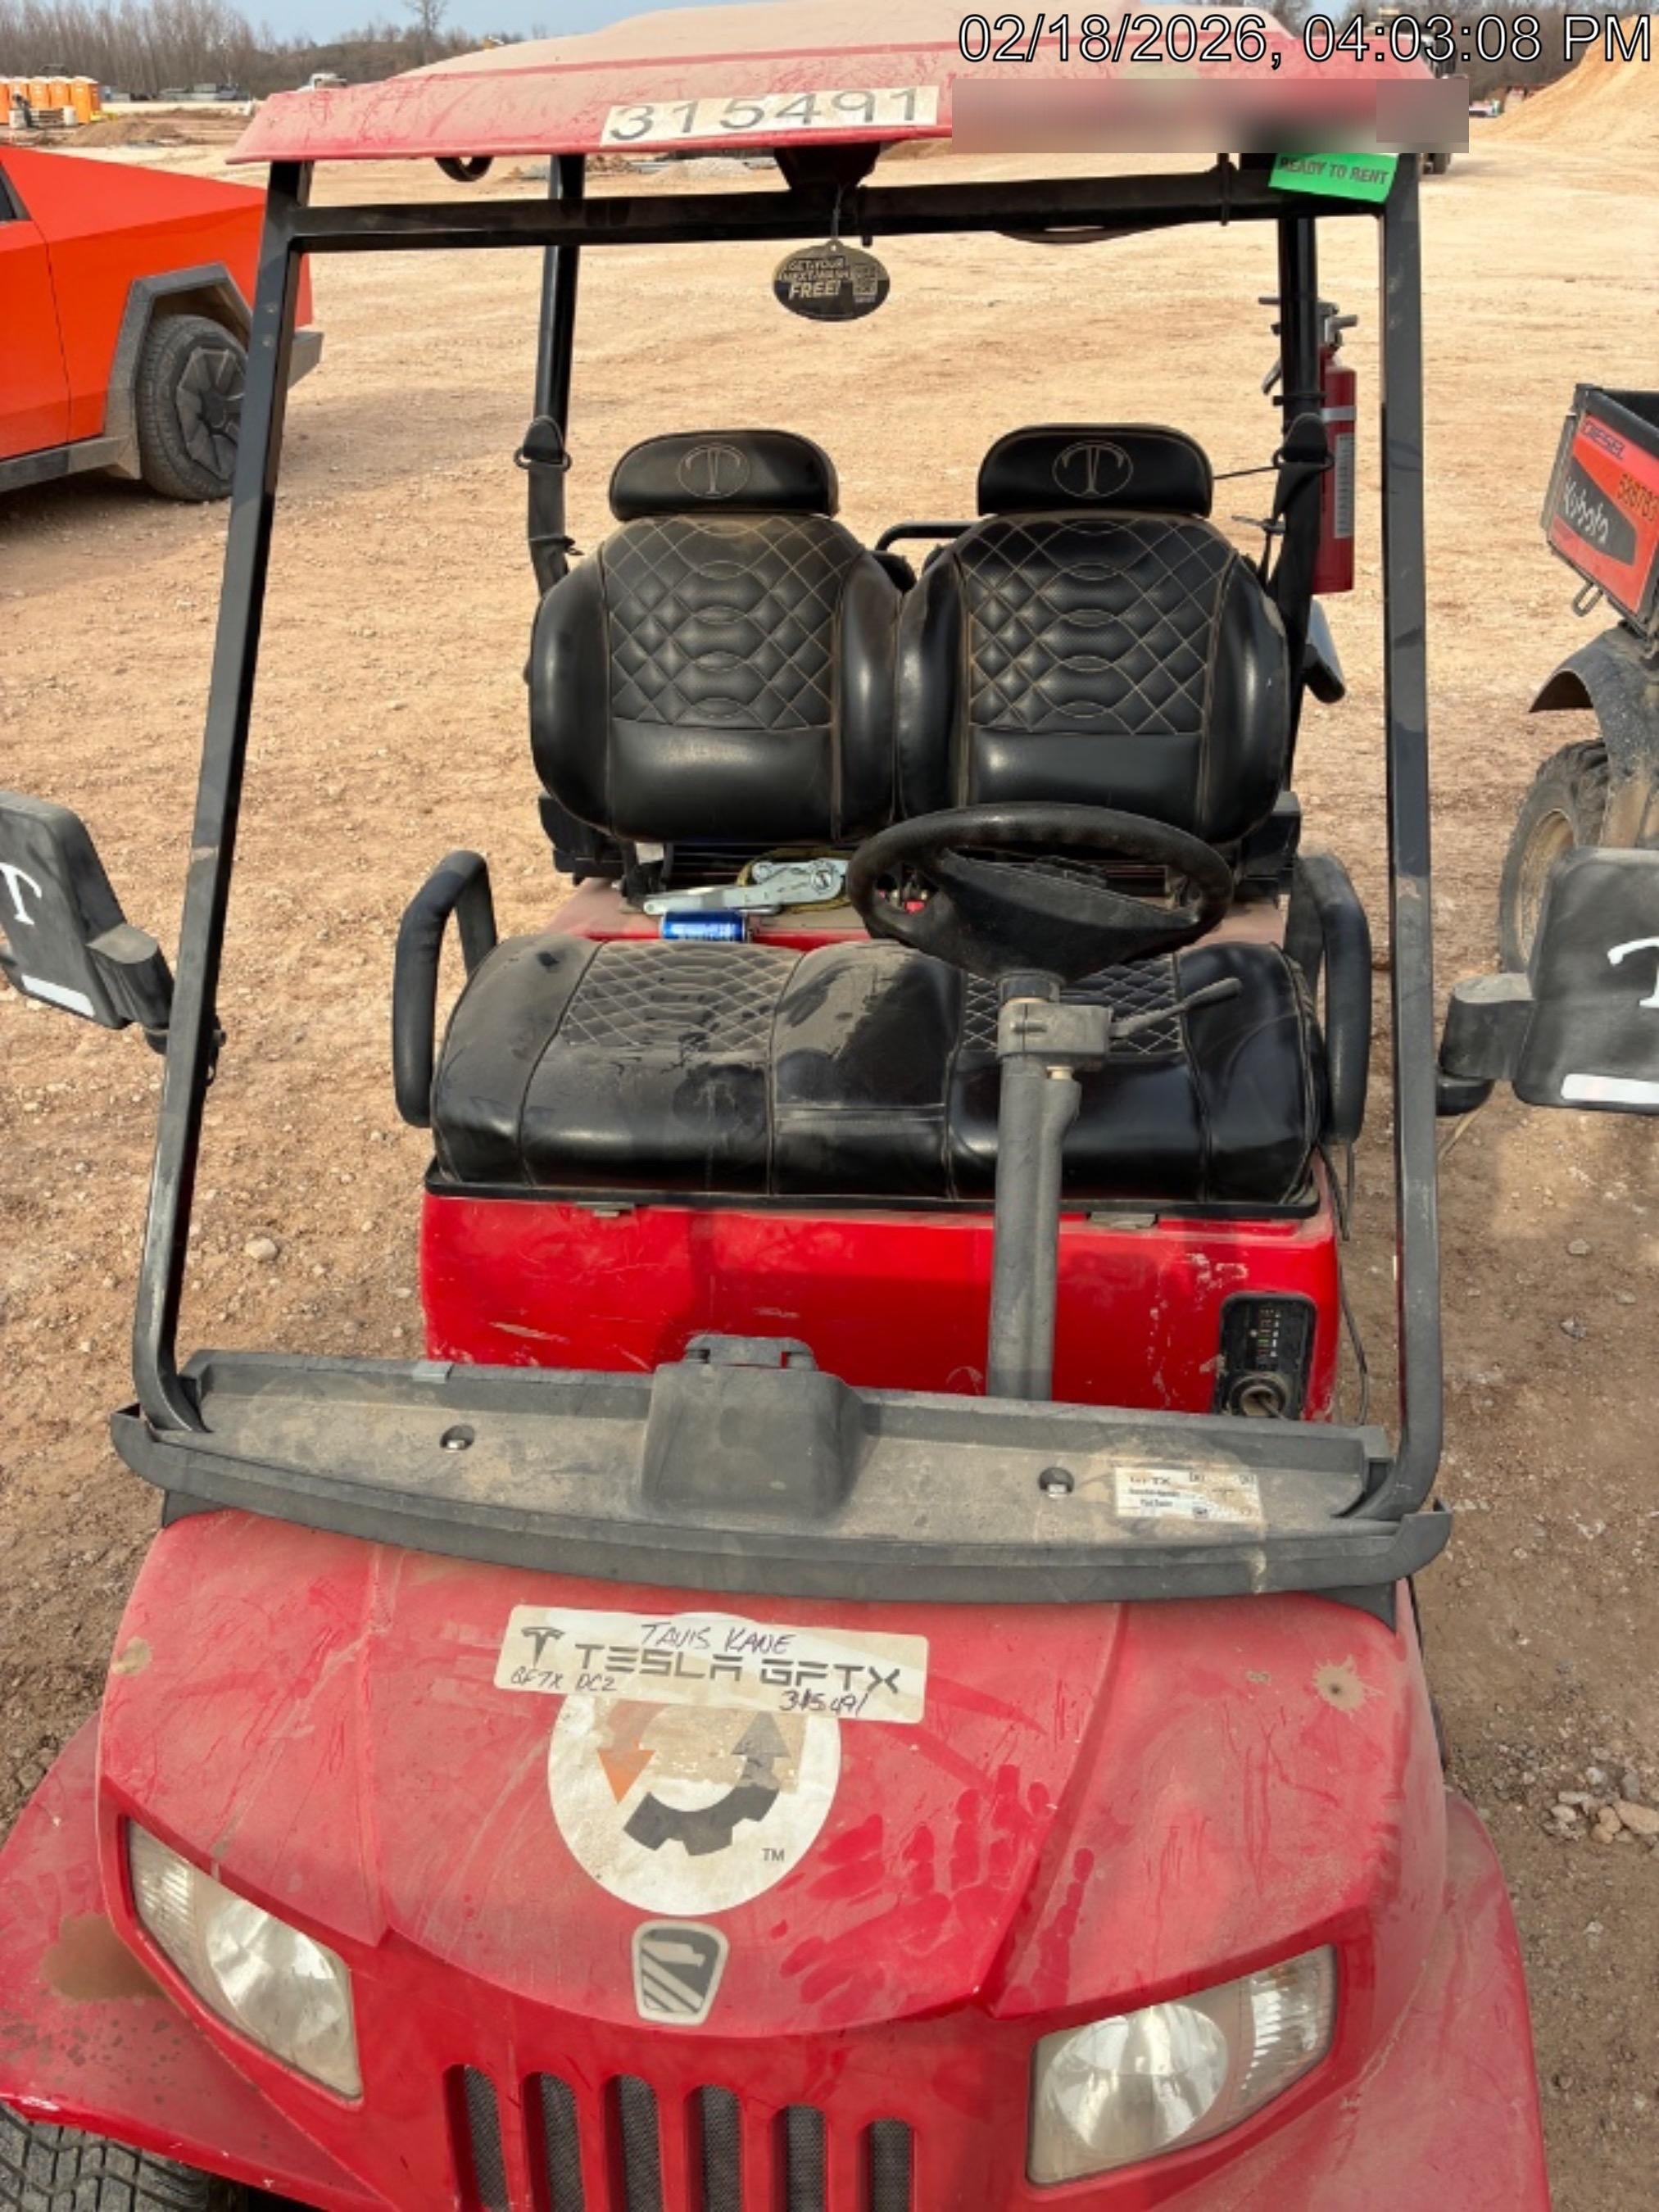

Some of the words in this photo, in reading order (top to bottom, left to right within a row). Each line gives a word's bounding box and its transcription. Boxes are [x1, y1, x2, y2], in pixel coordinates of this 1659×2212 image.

[610, 87, 918, 142] 315491
[1277, 156, 1326, 175] READY
[1330, 163, 1348, 179] TO
[1350, 166, 1389, 184] RENT
[789, 279, 841, 301] FREE!
[724, 1626, 796, 1655] KANE
[574, 1643, 743, 1682] TESLA
[759, 1658, 900, 1694] GFTX
